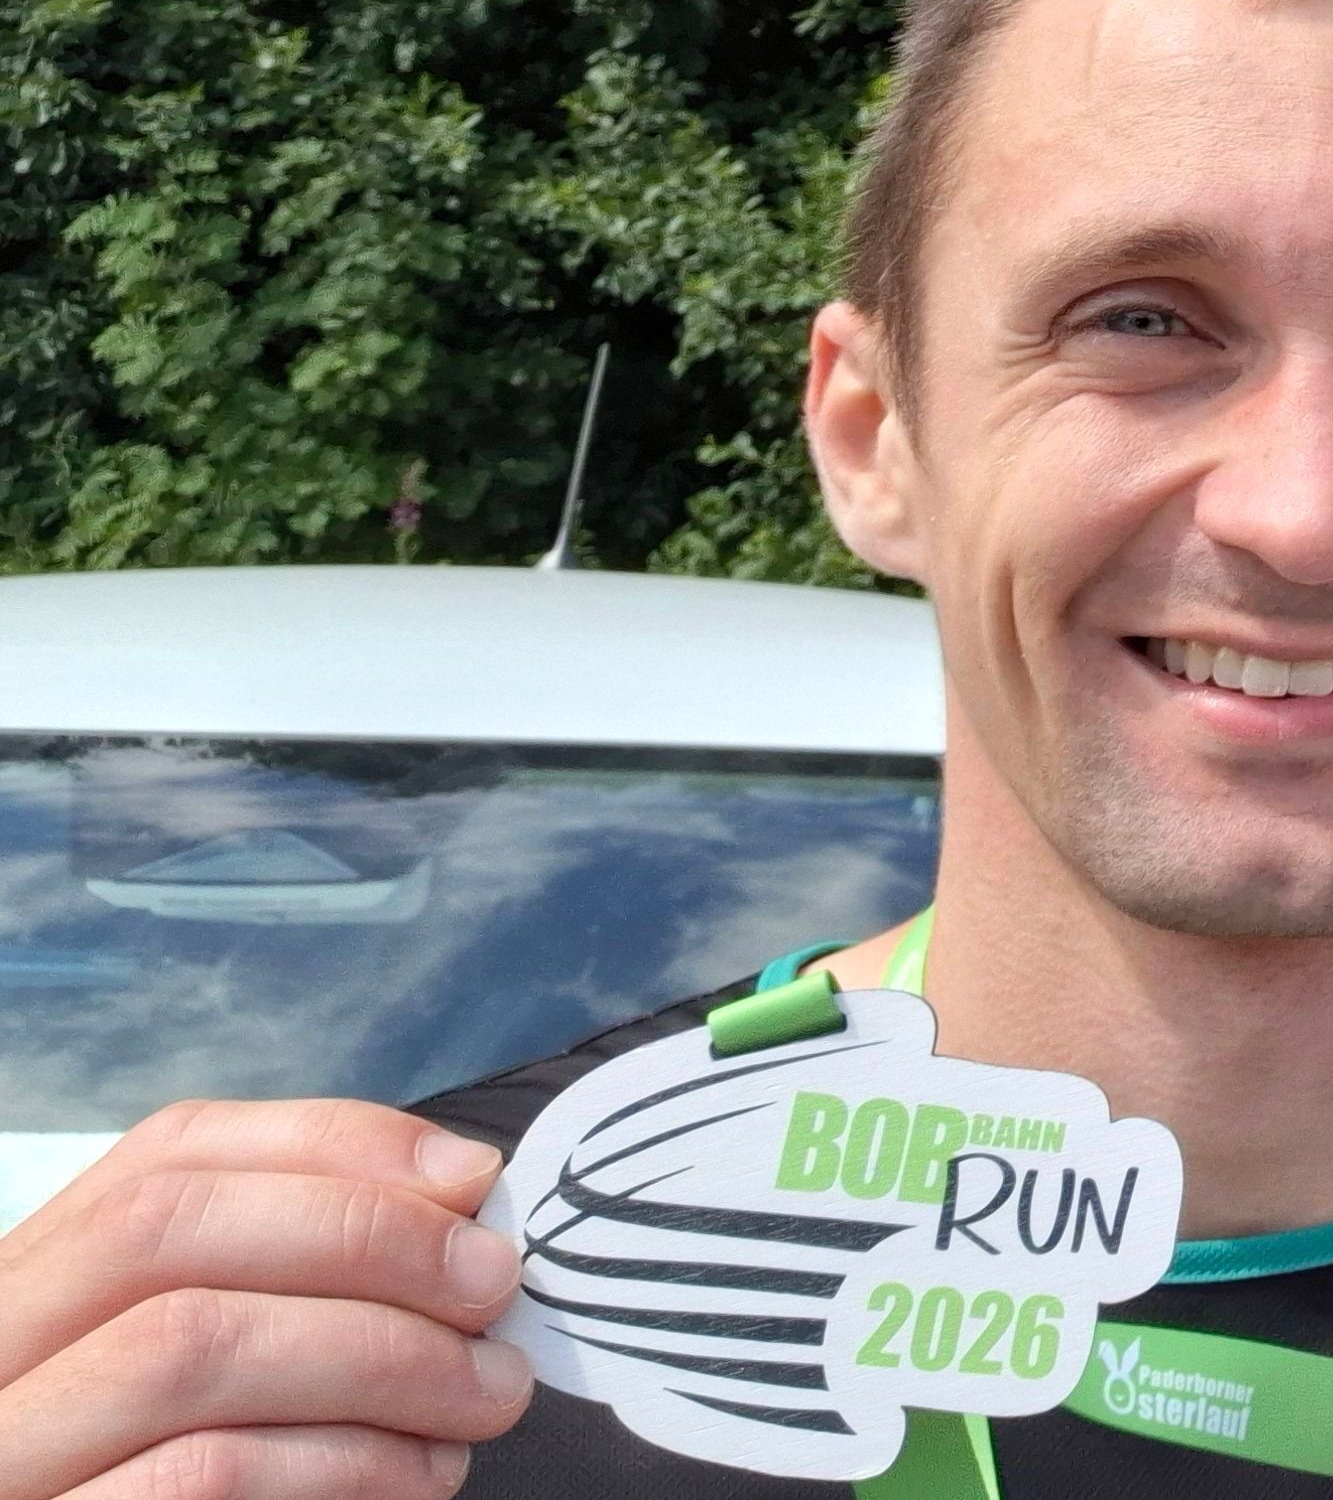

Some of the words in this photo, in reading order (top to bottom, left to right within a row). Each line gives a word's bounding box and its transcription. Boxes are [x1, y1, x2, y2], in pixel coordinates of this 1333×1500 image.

[774, 1090, 969, 1205] BOB
[968, 1112, 1067, 1153] BAHN
[935, 1153, 1139, 1255] RUN
[855, 1281, 1065, 1380] 2026
[1138, 1365, 1255, 1404] Paderborner
